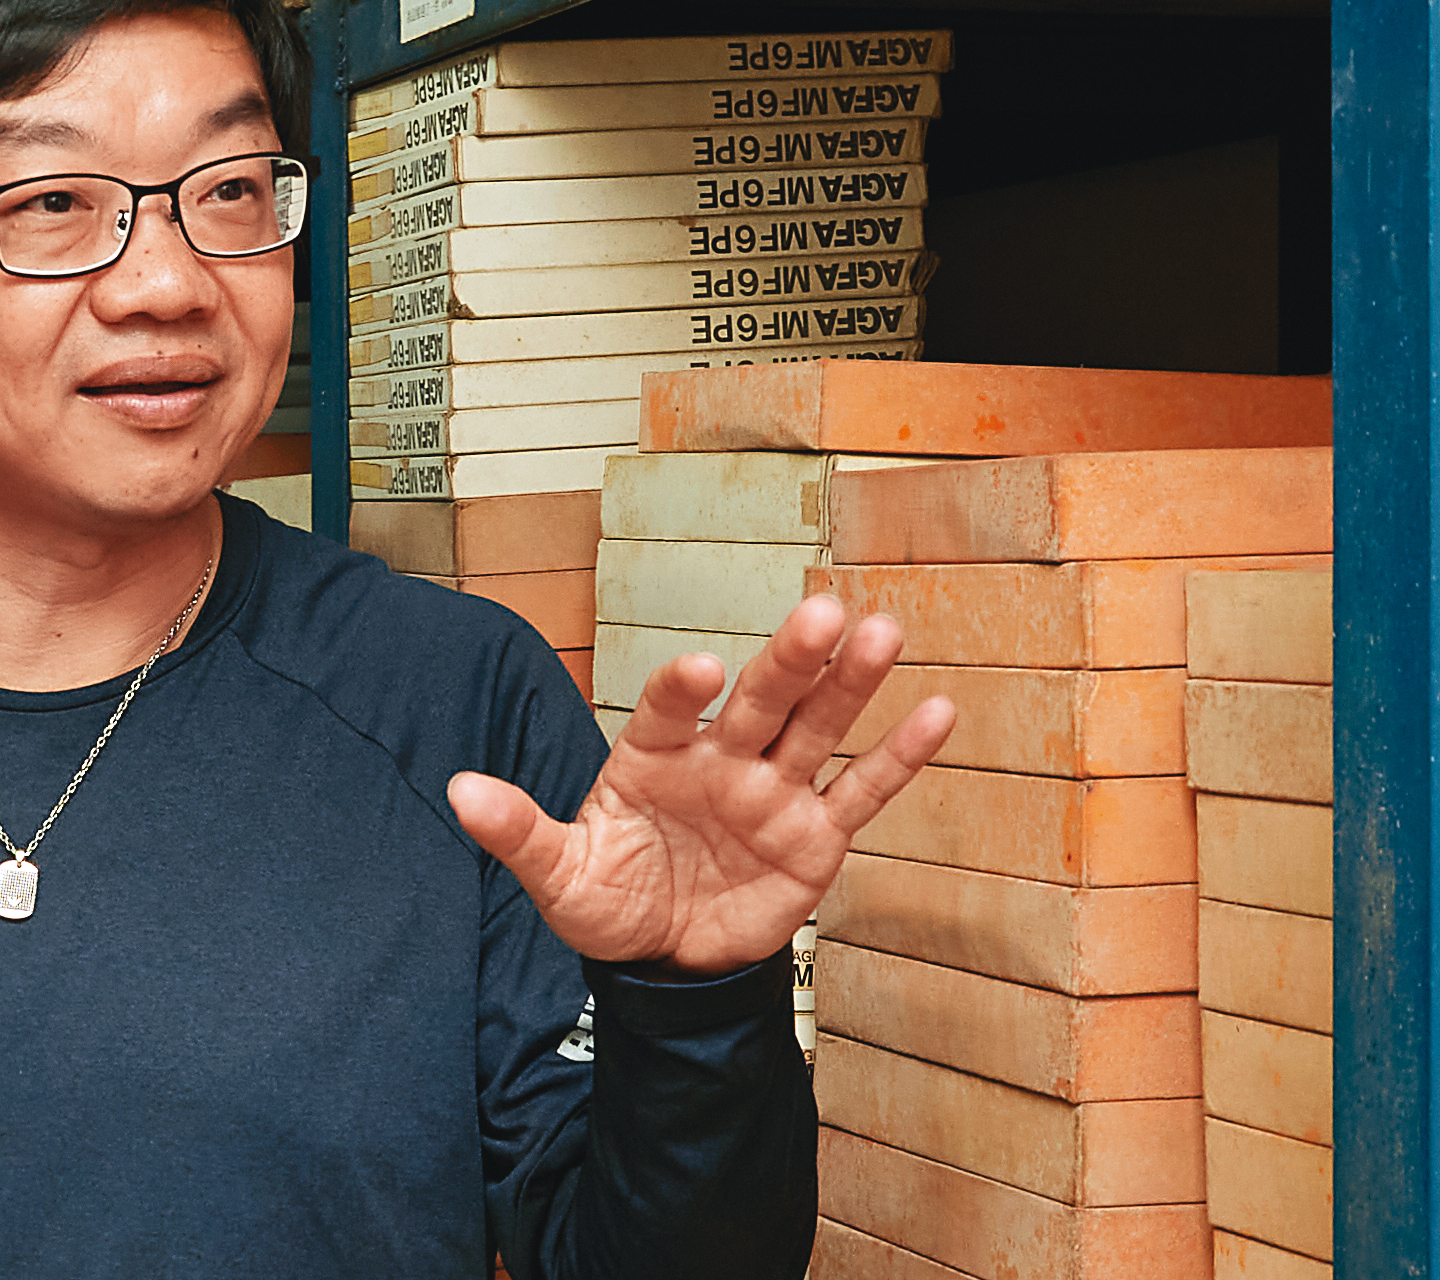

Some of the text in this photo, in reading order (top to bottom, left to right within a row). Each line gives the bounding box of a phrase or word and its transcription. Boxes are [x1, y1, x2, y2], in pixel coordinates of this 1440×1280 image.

[846, 38, 932, 66] AGFA
[833, 84, 920, 114] AGFA
[817, 129, 906, 159] AGFA
[819, 172, 908, 203] AGFA
[813, 216, 903, 248] AGFA
[815, 259, 905, 291] AGFA
[813, 305, 904, 336] AGFA
